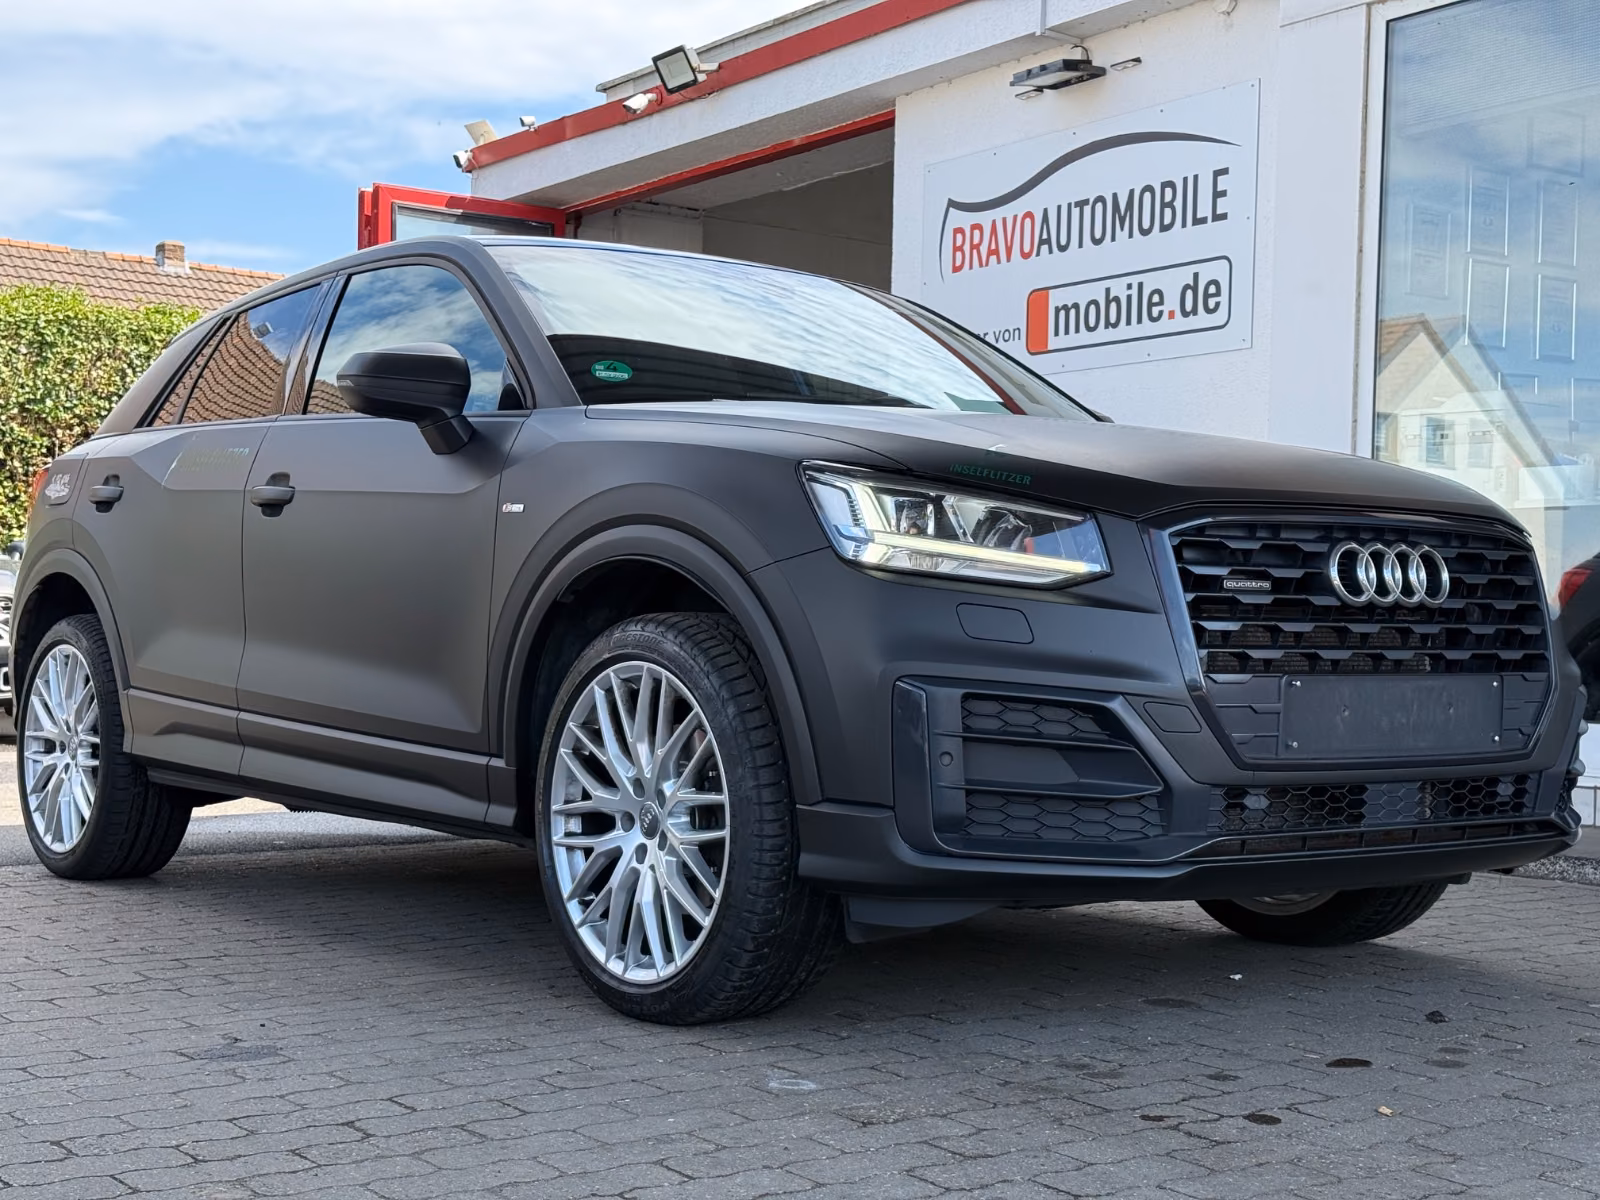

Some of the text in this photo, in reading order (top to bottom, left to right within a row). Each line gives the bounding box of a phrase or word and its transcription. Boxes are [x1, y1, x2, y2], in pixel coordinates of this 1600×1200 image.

[952, 167, 1229, 273] BRAVOAUTOMOBILE
[1053, 272, 1221, 337] mobile.de
[992, 326, 1021, 344] von
[949, 464, 1031, 485] INSELFLITZER
